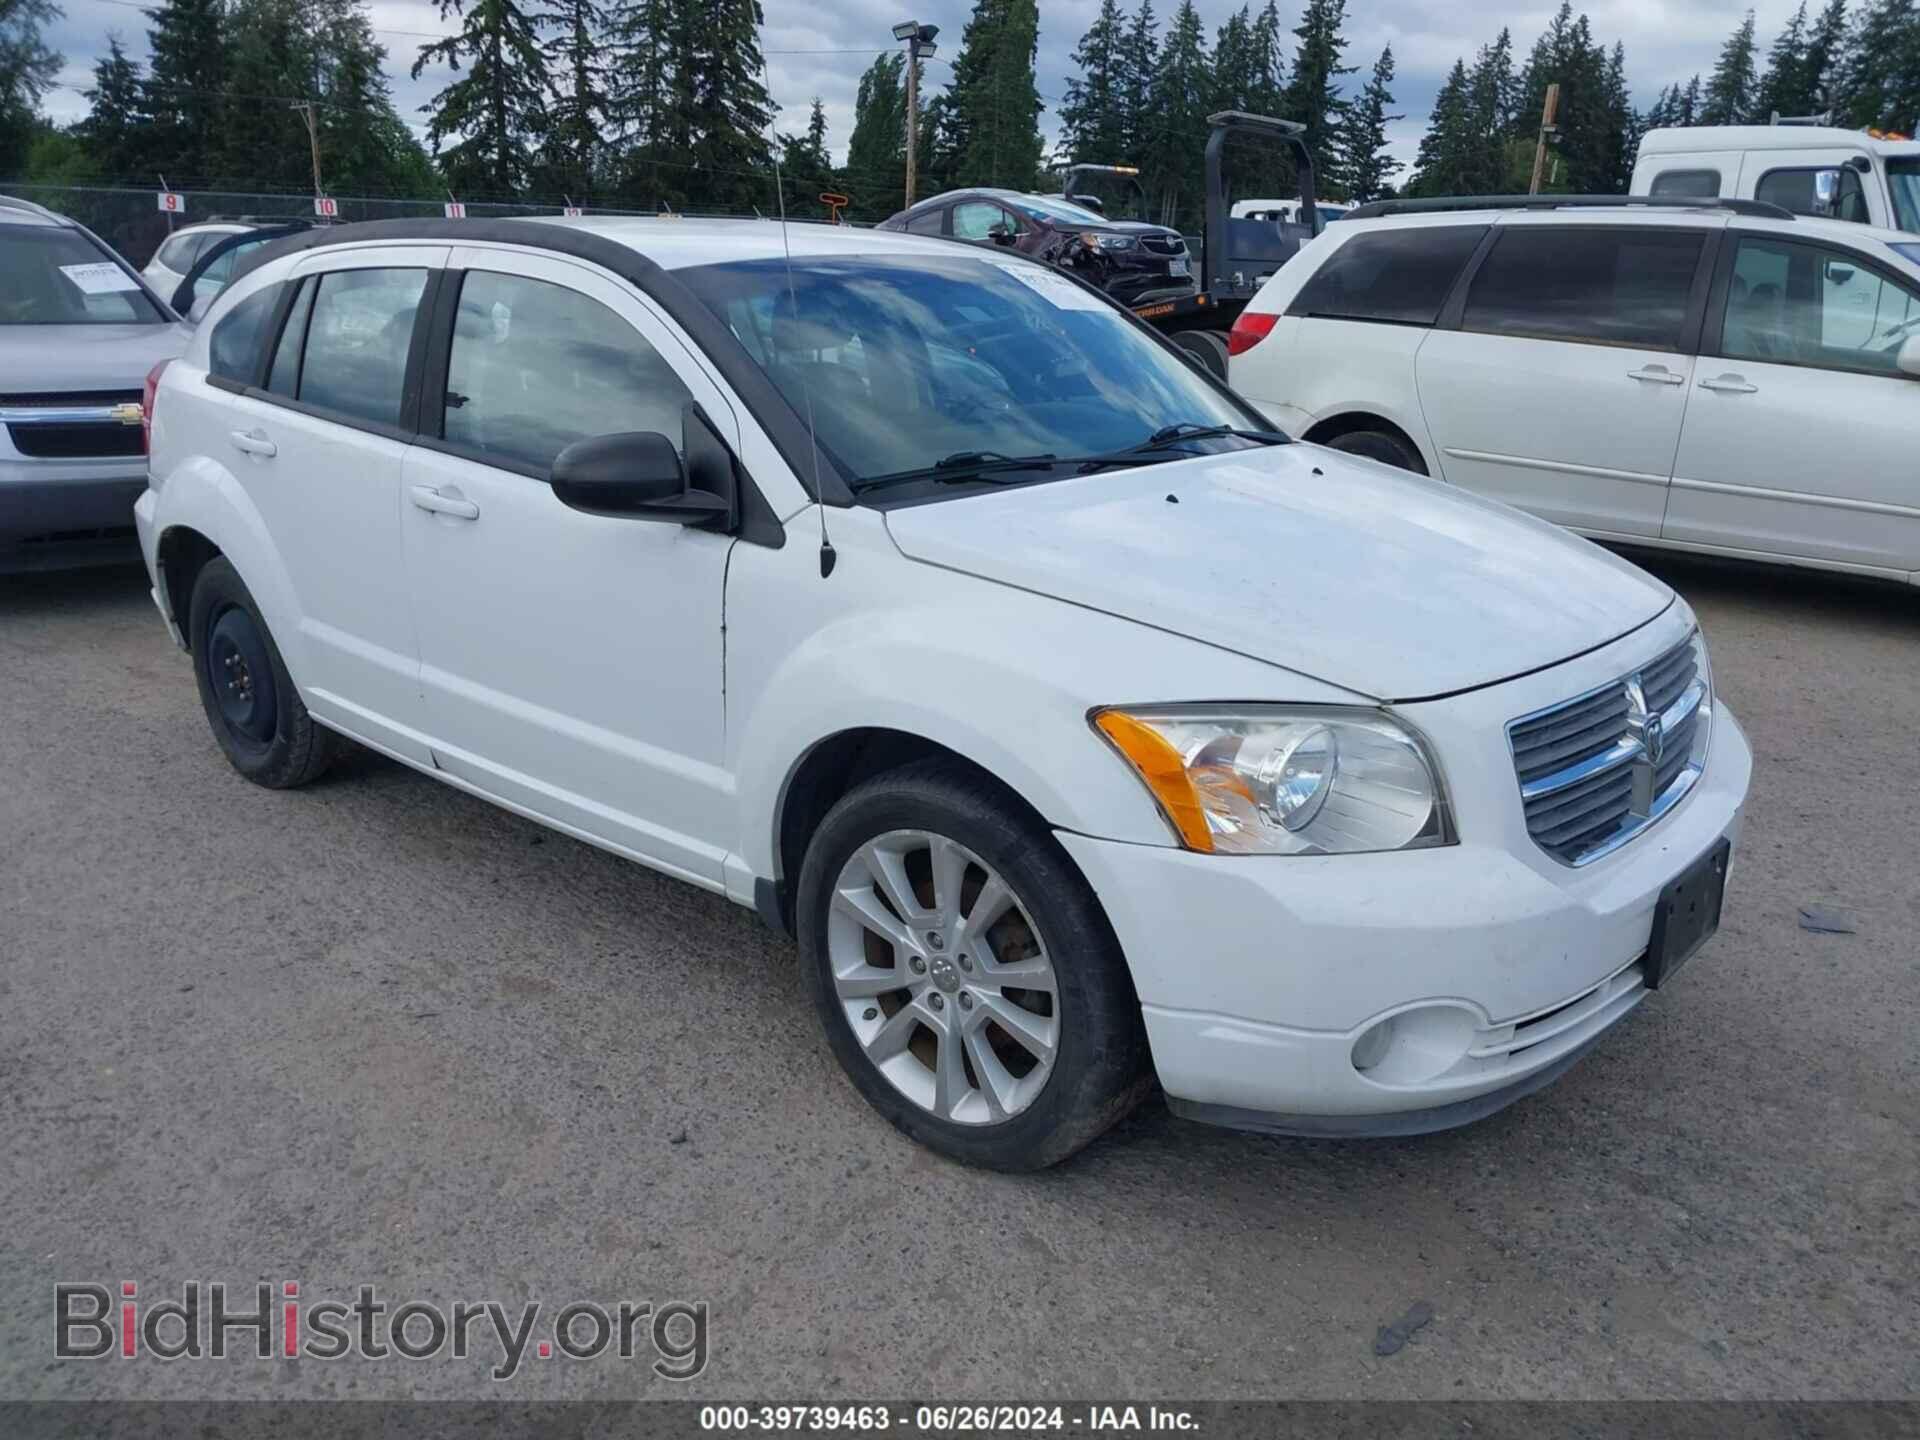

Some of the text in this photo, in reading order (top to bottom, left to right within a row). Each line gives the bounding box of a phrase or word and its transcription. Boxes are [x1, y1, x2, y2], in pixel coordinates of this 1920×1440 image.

[166, 195, 177, 210] 9
[319, 199, 334, 215] 10
[450, 205, 461, 218] 11
